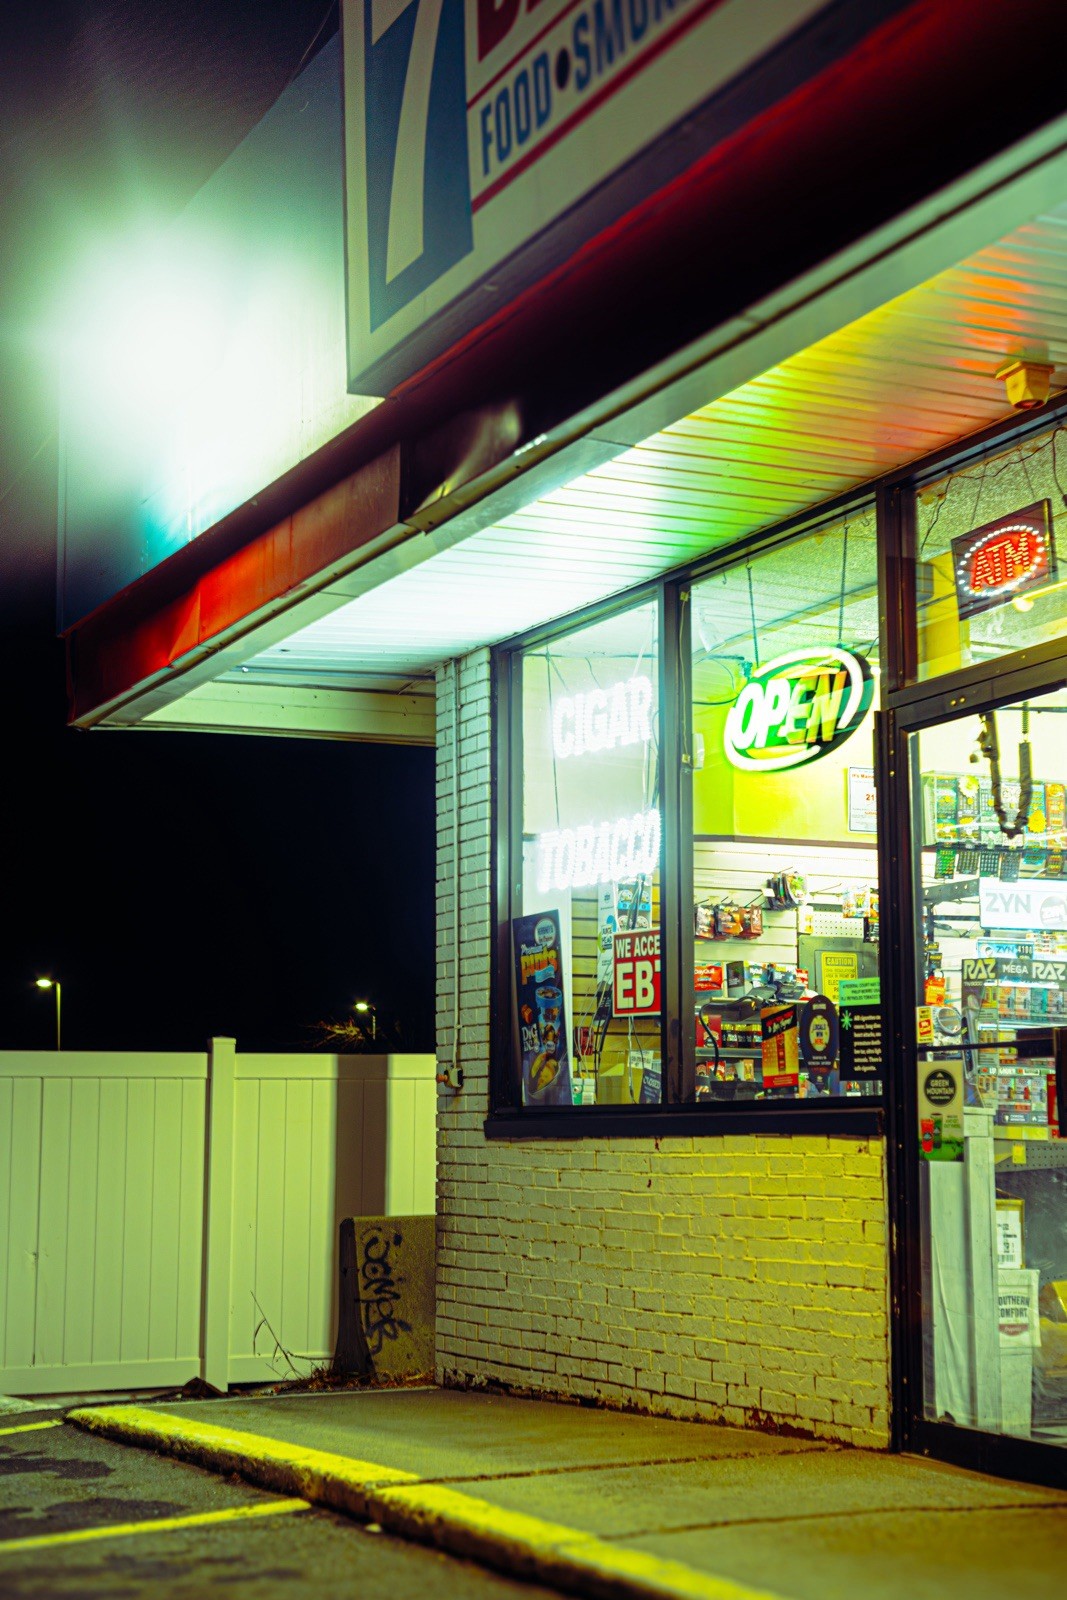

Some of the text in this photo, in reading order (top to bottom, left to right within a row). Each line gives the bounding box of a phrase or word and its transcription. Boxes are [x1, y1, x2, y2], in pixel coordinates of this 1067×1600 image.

[480, 52, 552, 177] FOOD
[572, 0, 687, 93] SMO
[973, 533, 1031, 591] ATM
[553, 676, 652, 758] CIGAR
[730, 669, 848, 750] OPEN
[985, 892, 1031, 914] ZYN
[616, 937, 632, 958] WE
[963, 958, 996, 980] RAZ
[1002, 962, 1066, 980] MEGA RAZ
[616, 960, 661, 1010] EB
